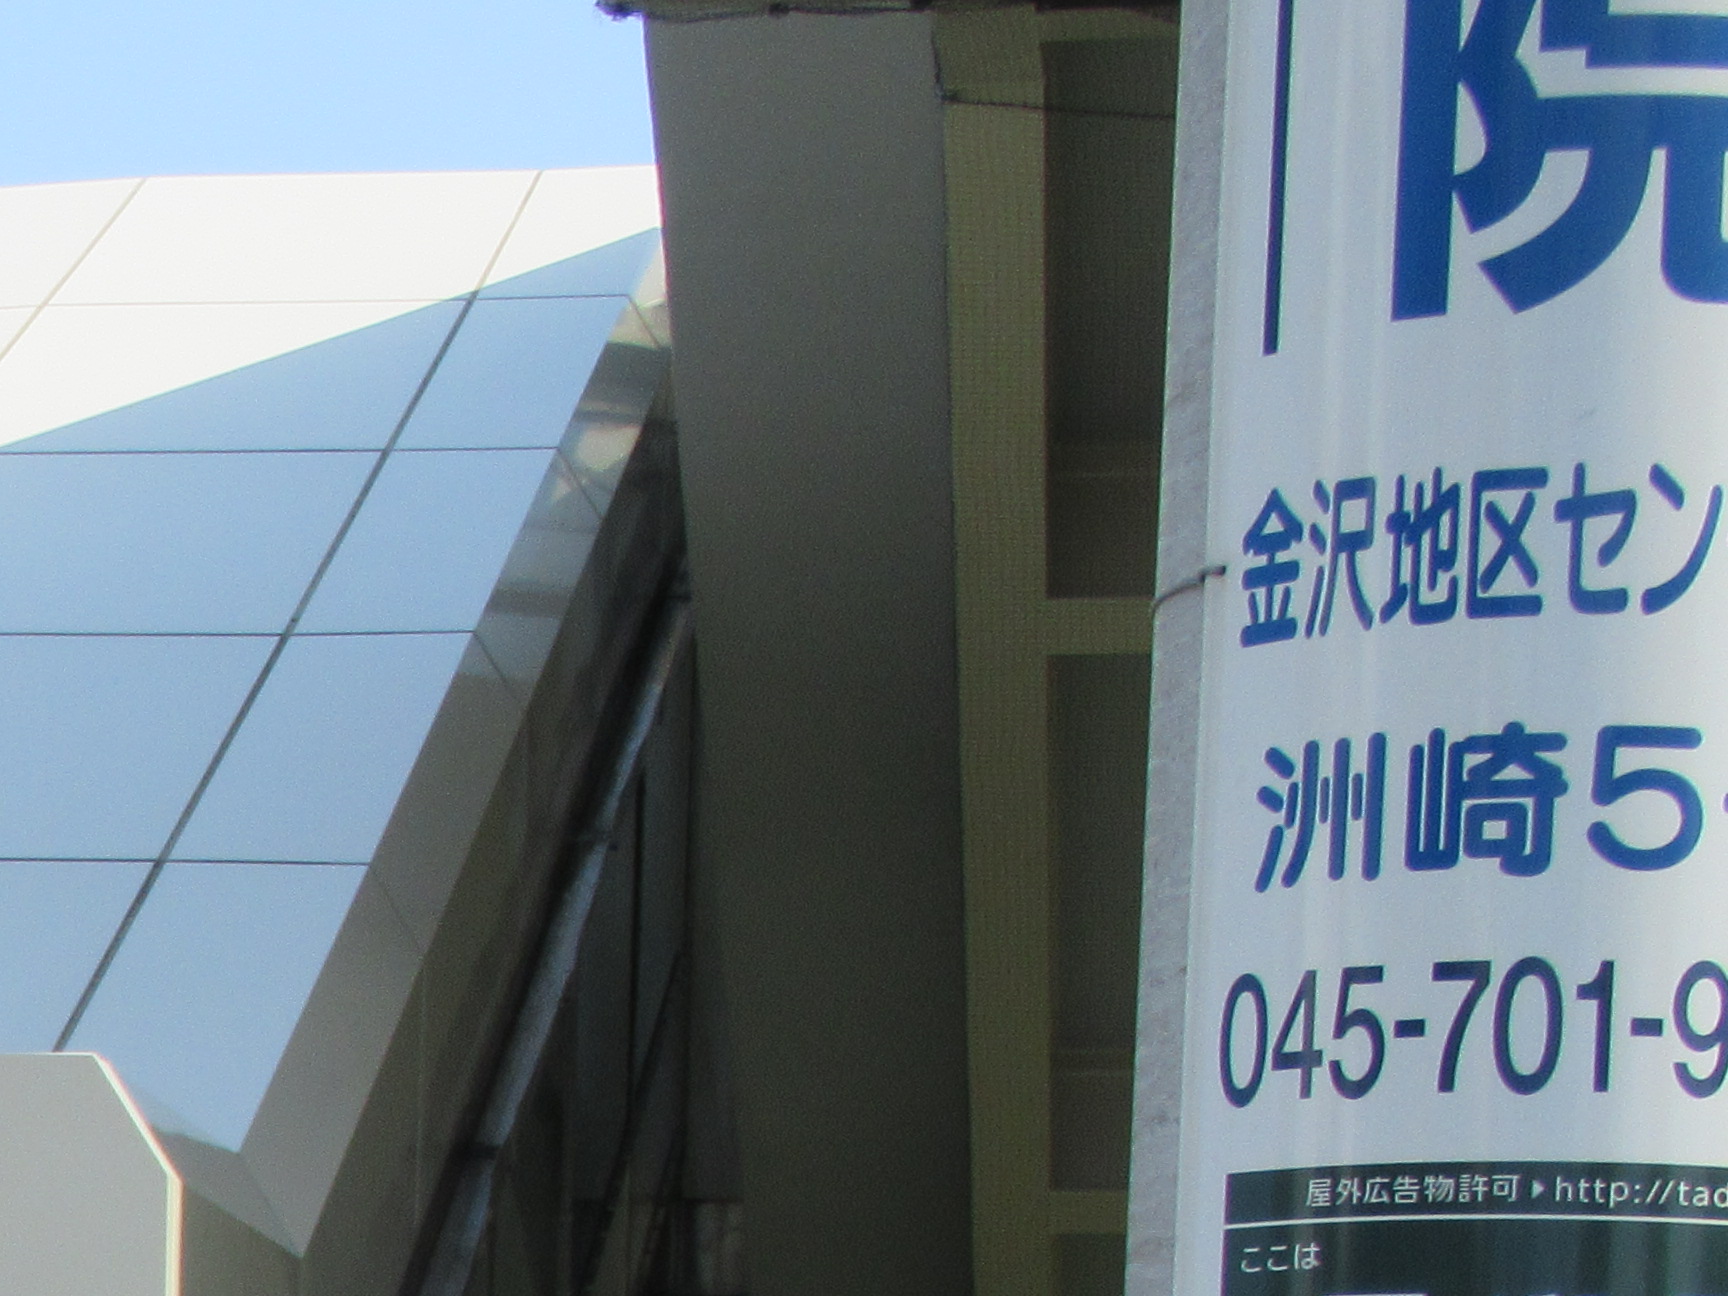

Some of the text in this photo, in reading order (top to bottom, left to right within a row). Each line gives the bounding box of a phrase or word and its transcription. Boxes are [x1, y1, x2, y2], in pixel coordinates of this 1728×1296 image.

[1240, 462, 1724, 648] 金沢地区セン
[1255, 721, 1728, 893] 洲崎5
[1218, 955, 1728, 1109] 045-701-9
[1241, 1242, 1321, 1273] ここは
[1306, 1174, 1521, 1208] 屋外広告物許可
